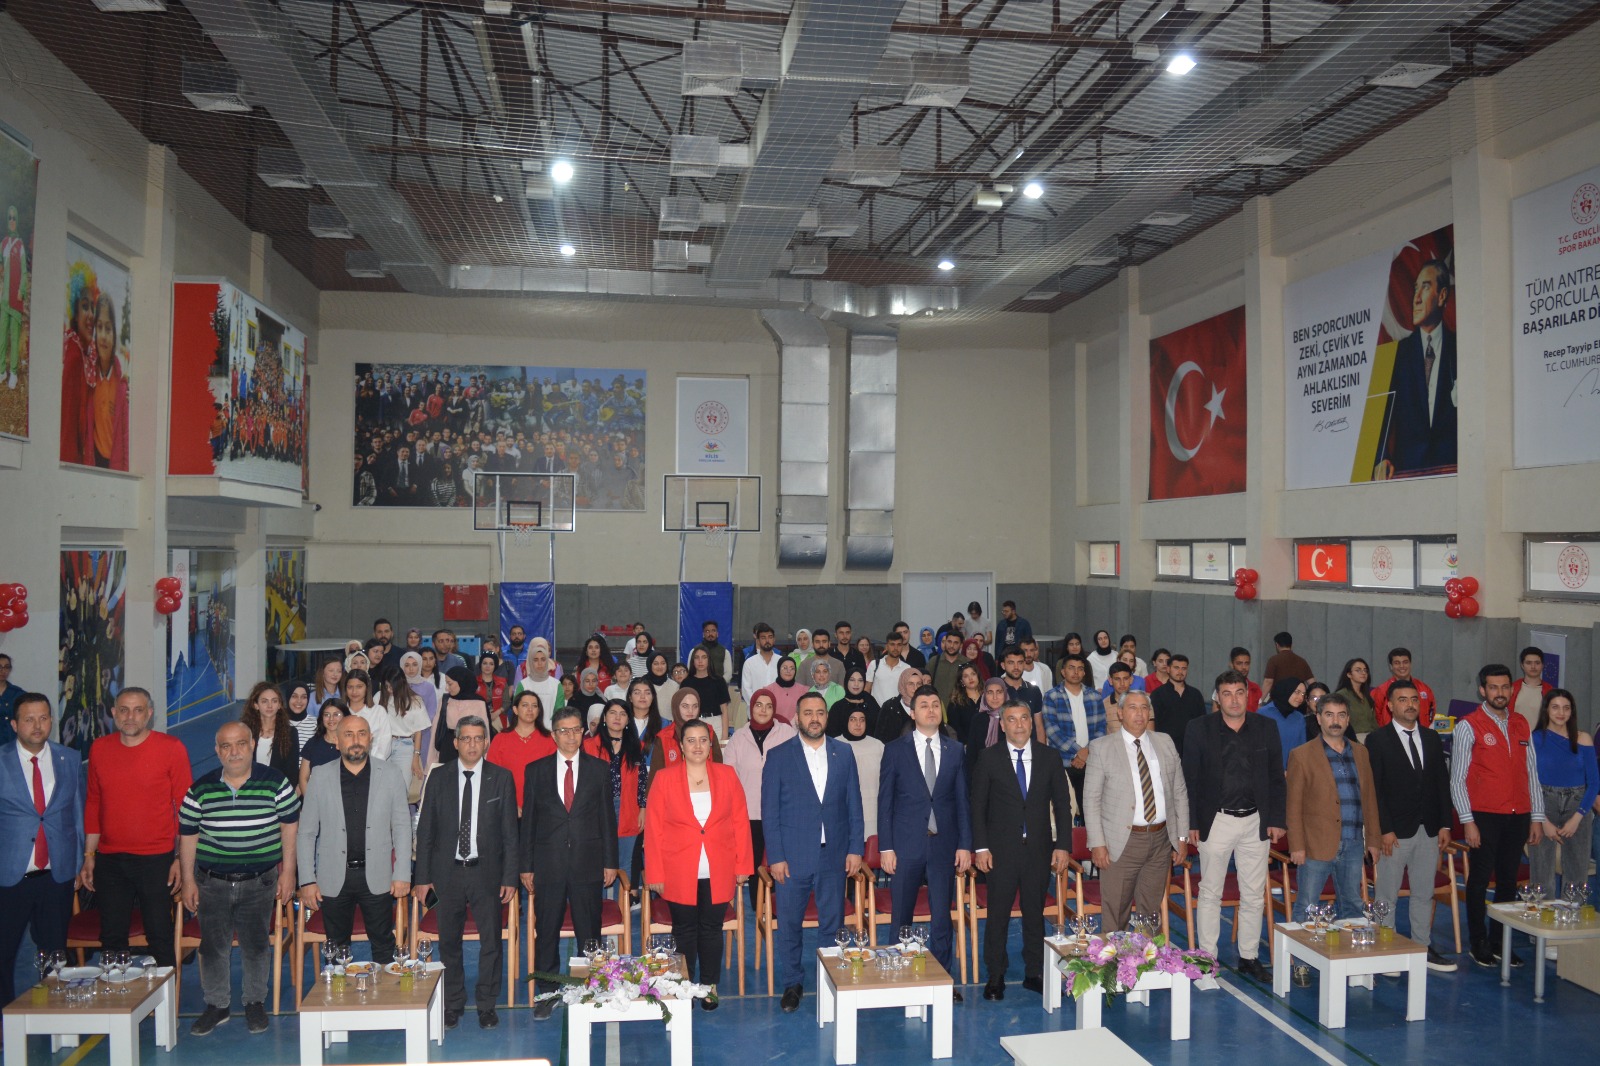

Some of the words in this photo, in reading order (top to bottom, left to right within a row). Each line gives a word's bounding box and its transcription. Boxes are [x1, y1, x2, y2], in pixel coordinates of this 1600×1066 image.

[1558, 235, 1571, 244] T.C.
[1558, 244, 1576, 256] SPOR
[1525, 277, 1554, 298] TÜM
[1557, 264, 1600, 290] ANTRE
[1530, 284, 1600, 315] SPORCULA
[1293, 326, 1310, 343] BEN
[1311, 308, 1371, 338] SPORCUNUN
[1523, 309, 1586, 335] BAŞARILAR
[1299, 340, 1320, 360] ZEKİ,
[1322, 333, 1350, 357] ÇEVİK
[1351, 330, 1364, 346] VE
[1544, 348, 1566, 359] Recep
[1566, 342, 1592, 355] Tayyip
[1297, 363, 1317, 379] AYNI
[1318, 350, 1368, 374] ZAMANDA
[1546, 362, 1559, 373] T.C.
[1303, 372, 1360, 397] AHLAKLISINI
[1311, 393, 1351, 414] SEVERİM
